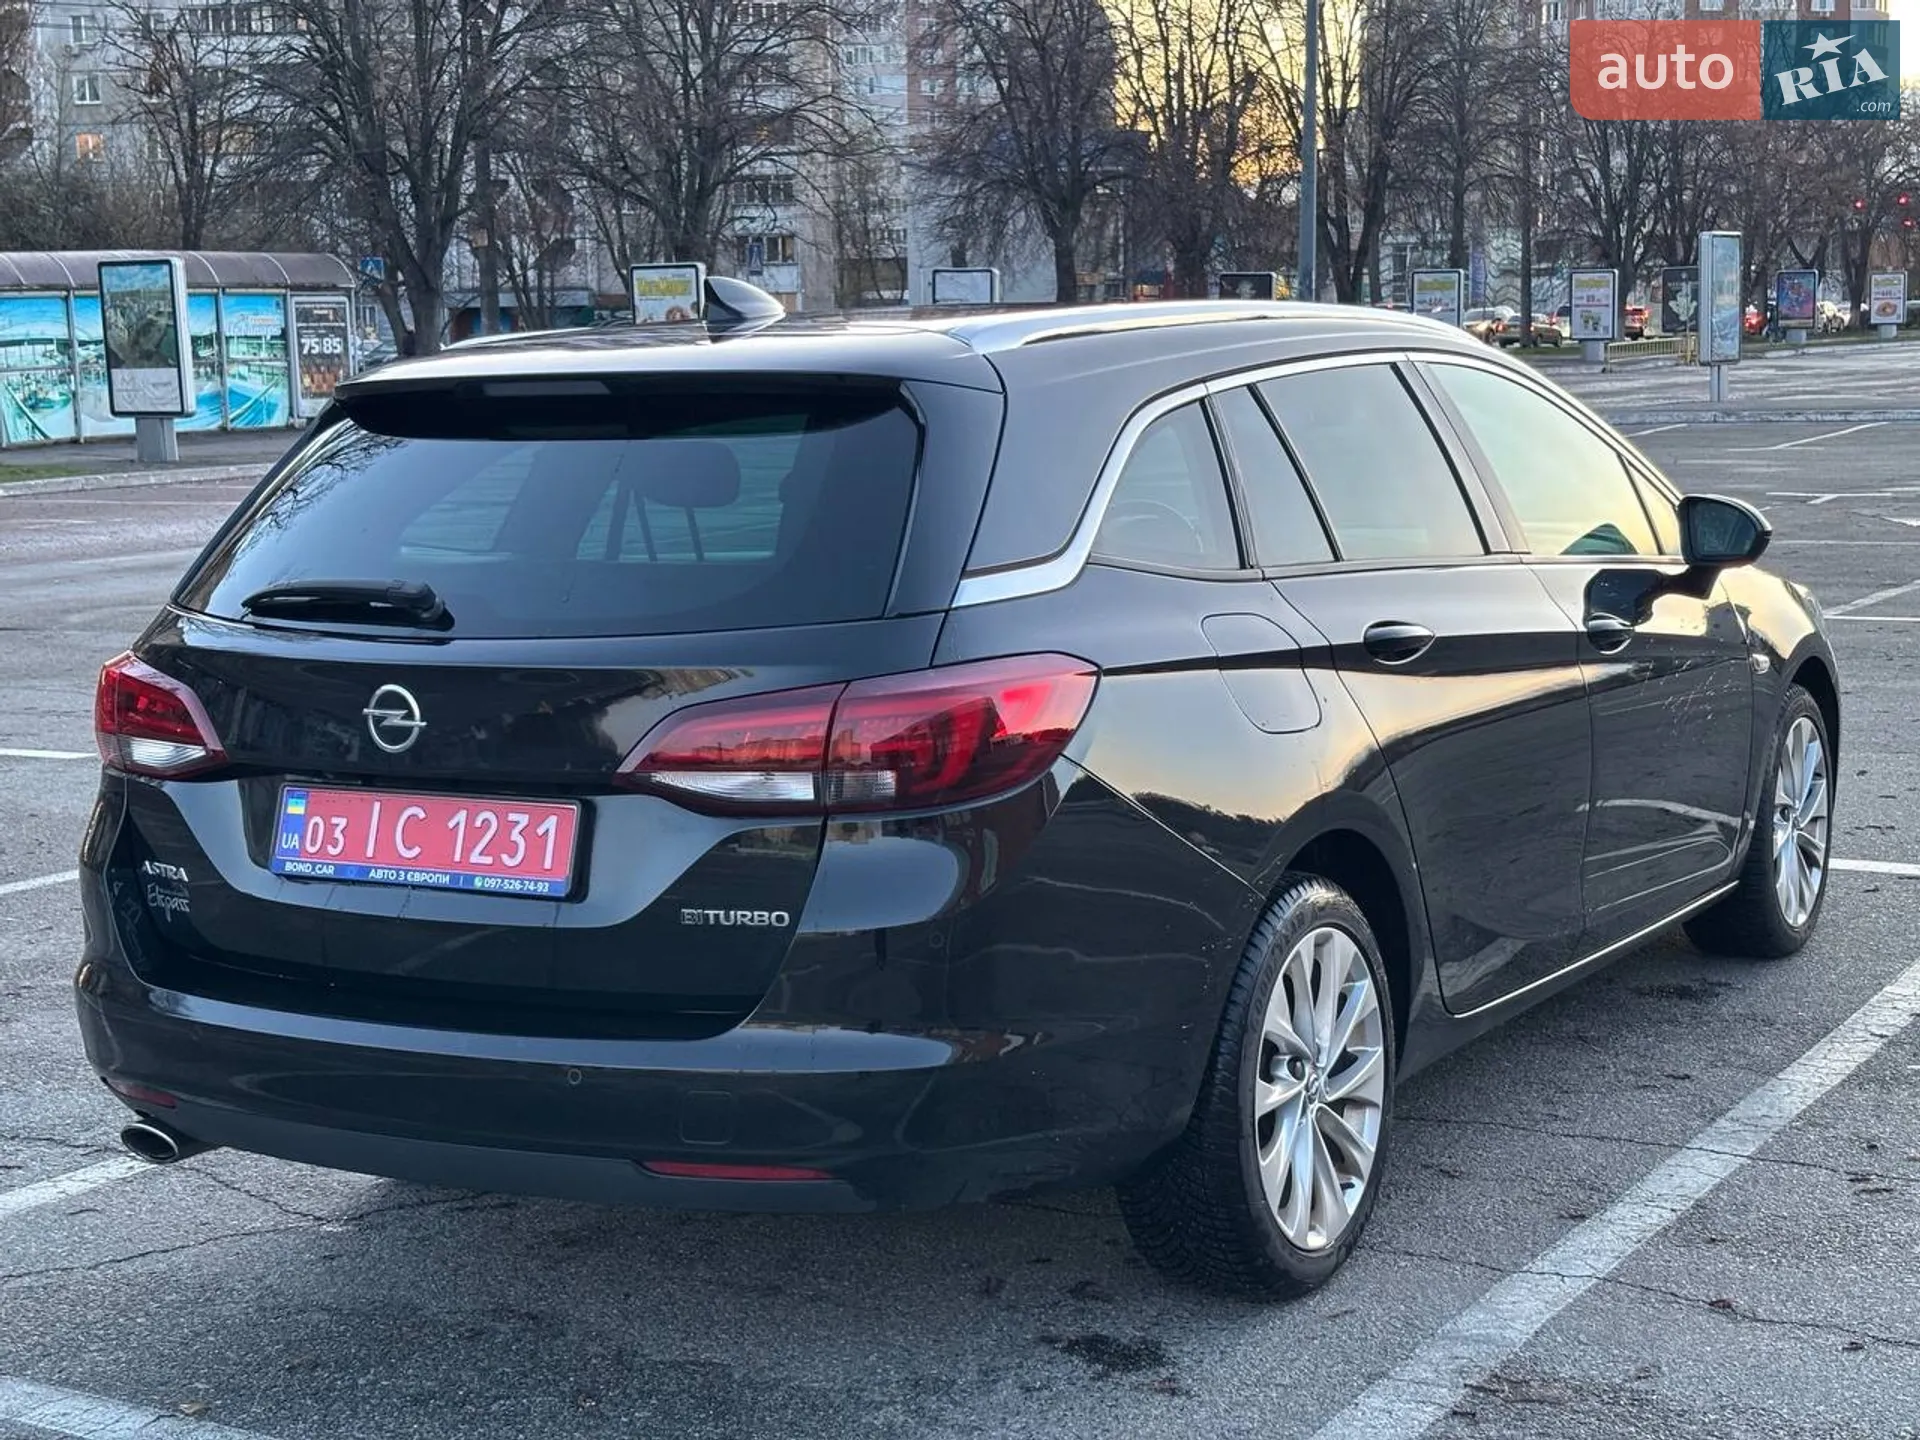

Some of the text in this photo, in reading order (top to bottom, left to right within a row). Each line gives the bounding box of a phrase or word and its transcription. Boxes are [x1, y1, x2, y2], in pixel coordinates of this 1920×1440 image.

[301, 338, 341, 354] 75 85
[282, 832, 299, 850] UA
[305, 816, 348, 856] 03
[447, 809, 559, 870] 1231
[142, 860, 189, 883] ASTRA
[284, 862, 334, 876] BOND_CAR
[369, 868, 395, 881] АВТО
[484, 876, 549, 893] 097-526-74-93
